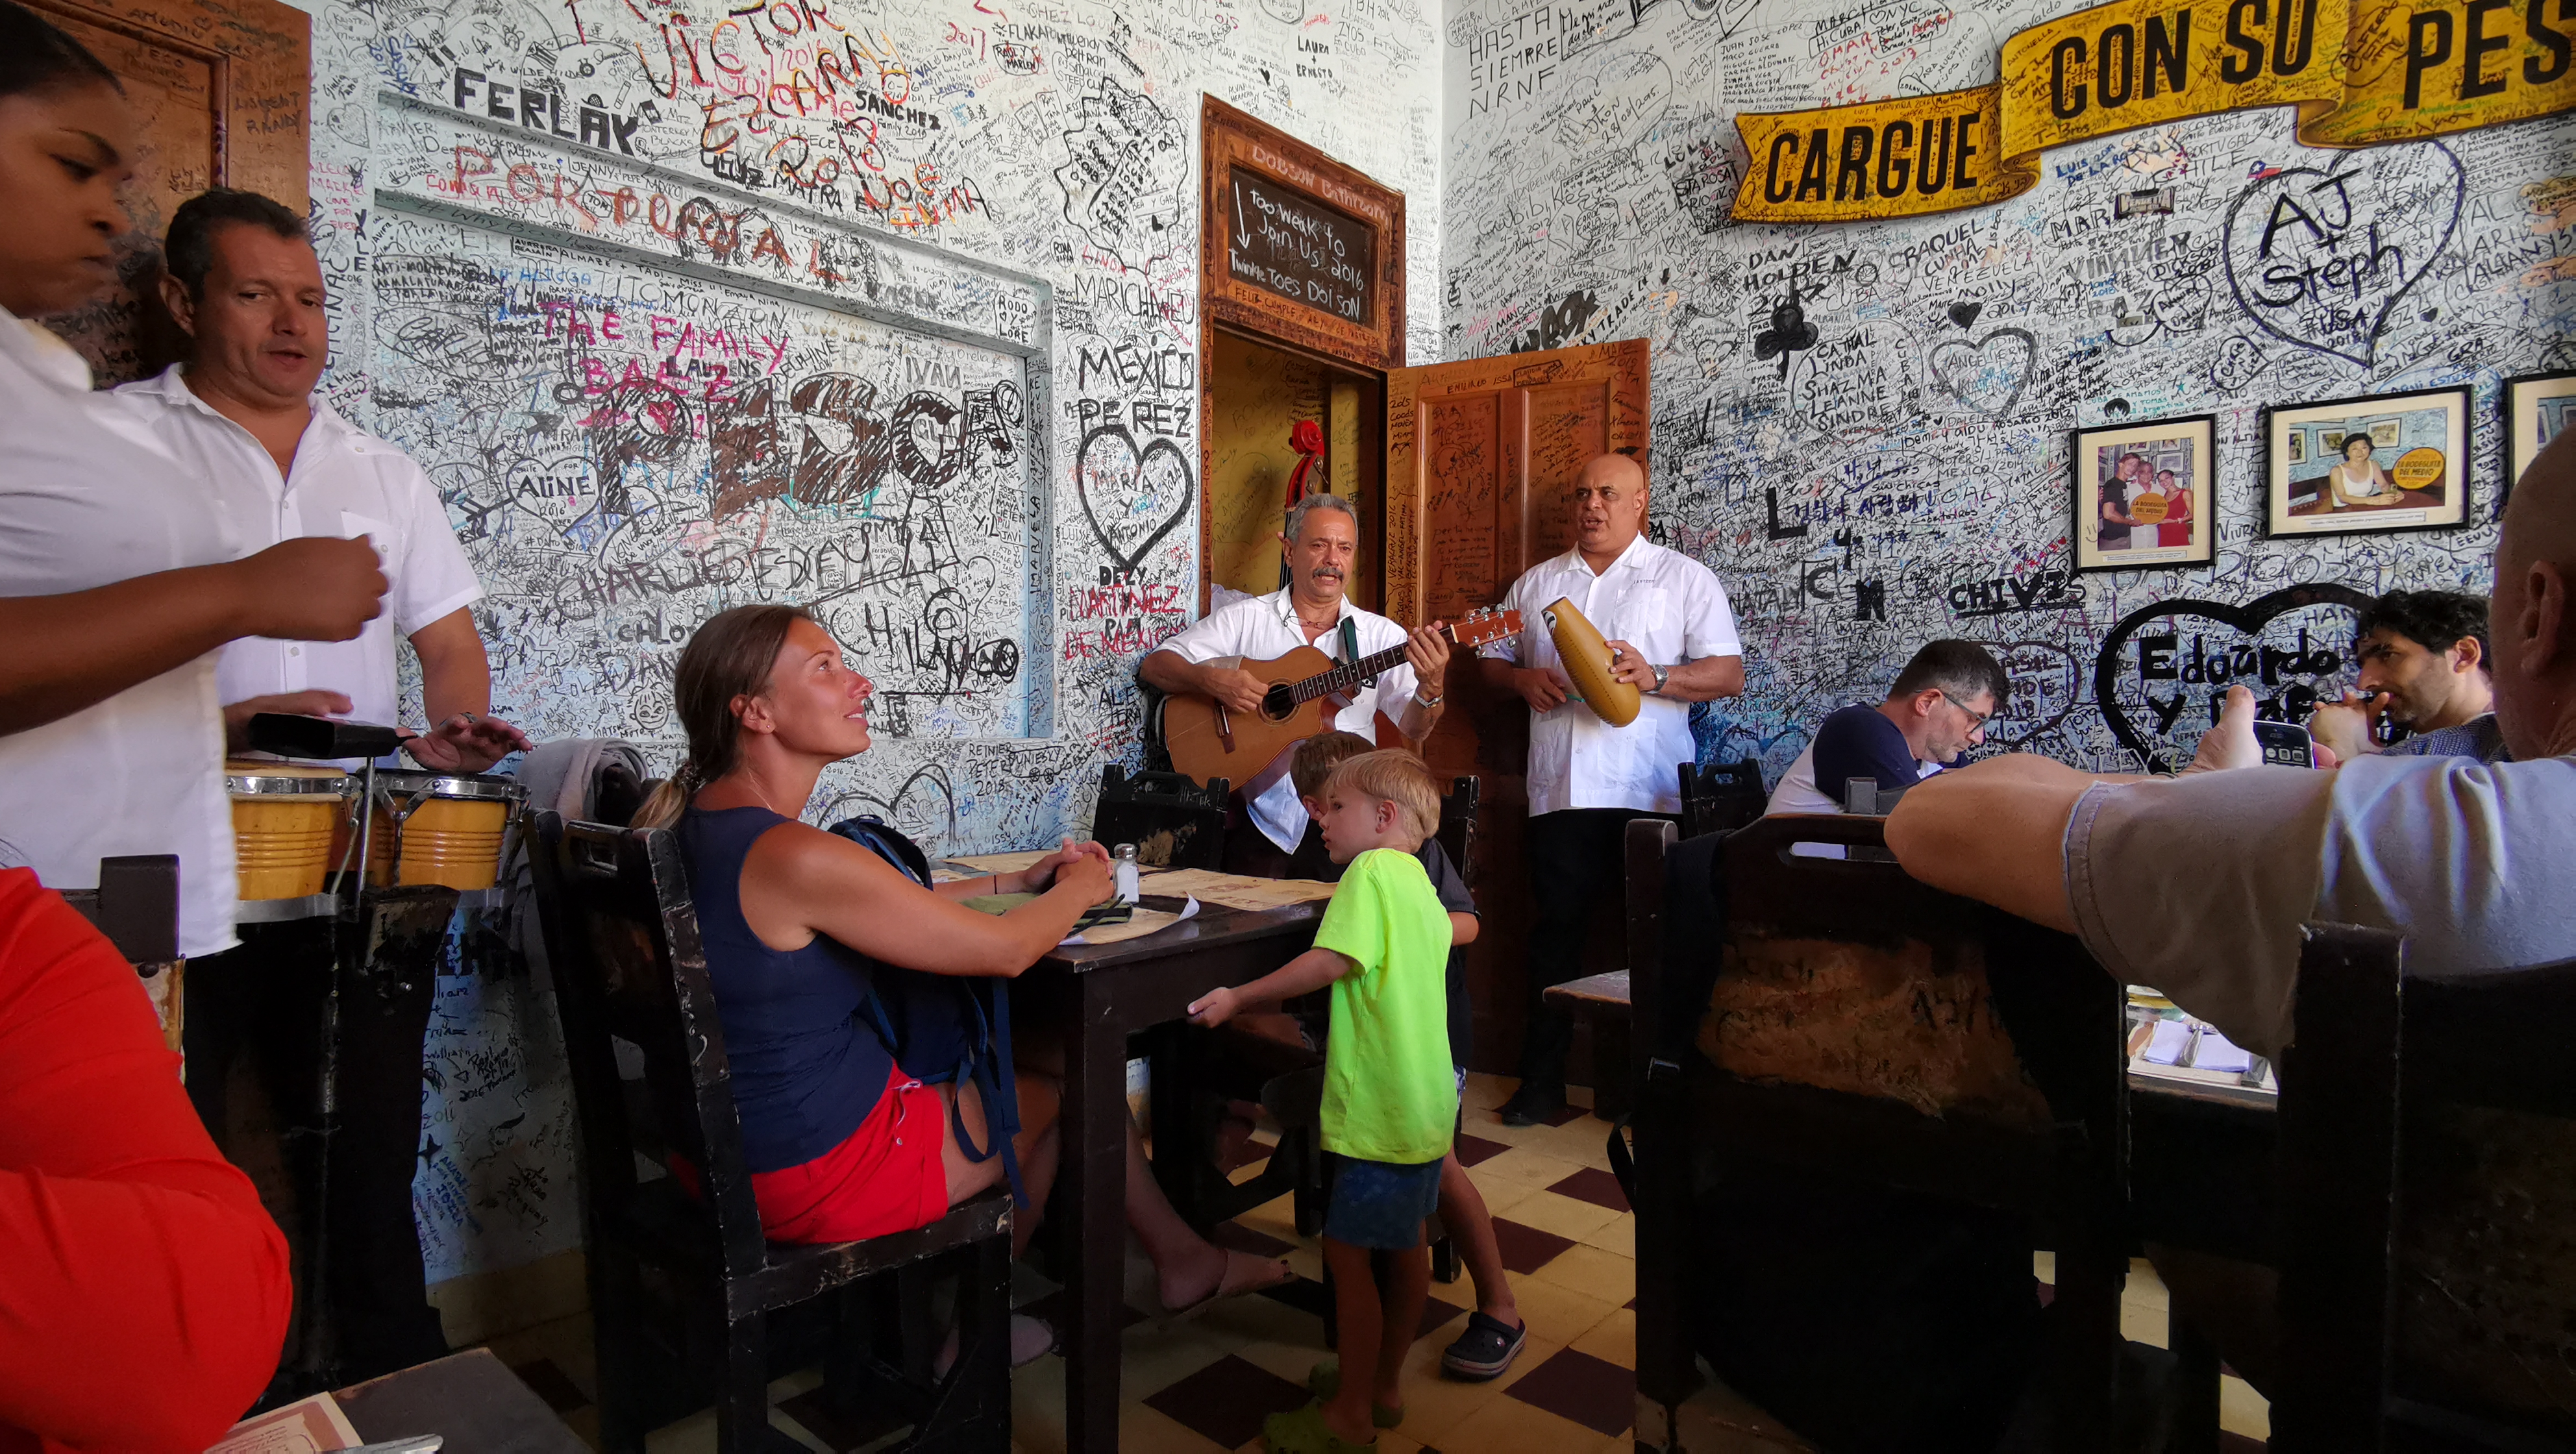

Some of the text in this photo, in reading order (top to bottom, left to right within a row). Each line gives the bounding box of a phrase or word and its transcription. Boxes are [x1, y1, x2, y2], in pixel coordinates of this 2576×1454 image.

[1298, 36, 1330, 55] LAURA
[1469, 6, 1550, 66] HASTA
[2403, 0, 2576, 110] PES
[1296, 64, 1333, 79] ERNESTO
[2051, 0, 2319, 120] CON SU
[454, 66, 638, 157] FERLAK
[856, 90, 941, 130] SANCHEZ
[1252, 145, 1317, 188] DOBSON
[1763, 111, 1981, 204] CARGUE
[2055, 157, 2088, 179] LUIS
[588, 192, 610, 209] TOM
[2259, 167, 2364, 260] AJ
[1257, 214, 1293, 250] Join
[1331, 256, 1365, 291] 2016
[1749, 243, 1800, 270] DAN
[1903, 218, 1984, 267] RAQUEL
[2261, 222, 2407, 306] Steph
[998, 294, 1028, 315] RODO
[649, 313, 789, 376] FAMILY
[999, 323, 1030, 344] LORE
[1817, 328, 1877, 358] CATHAL
[1070, 583, 1187, 619] MARTINEZ
[1065, 631, 1096, 661] DE
